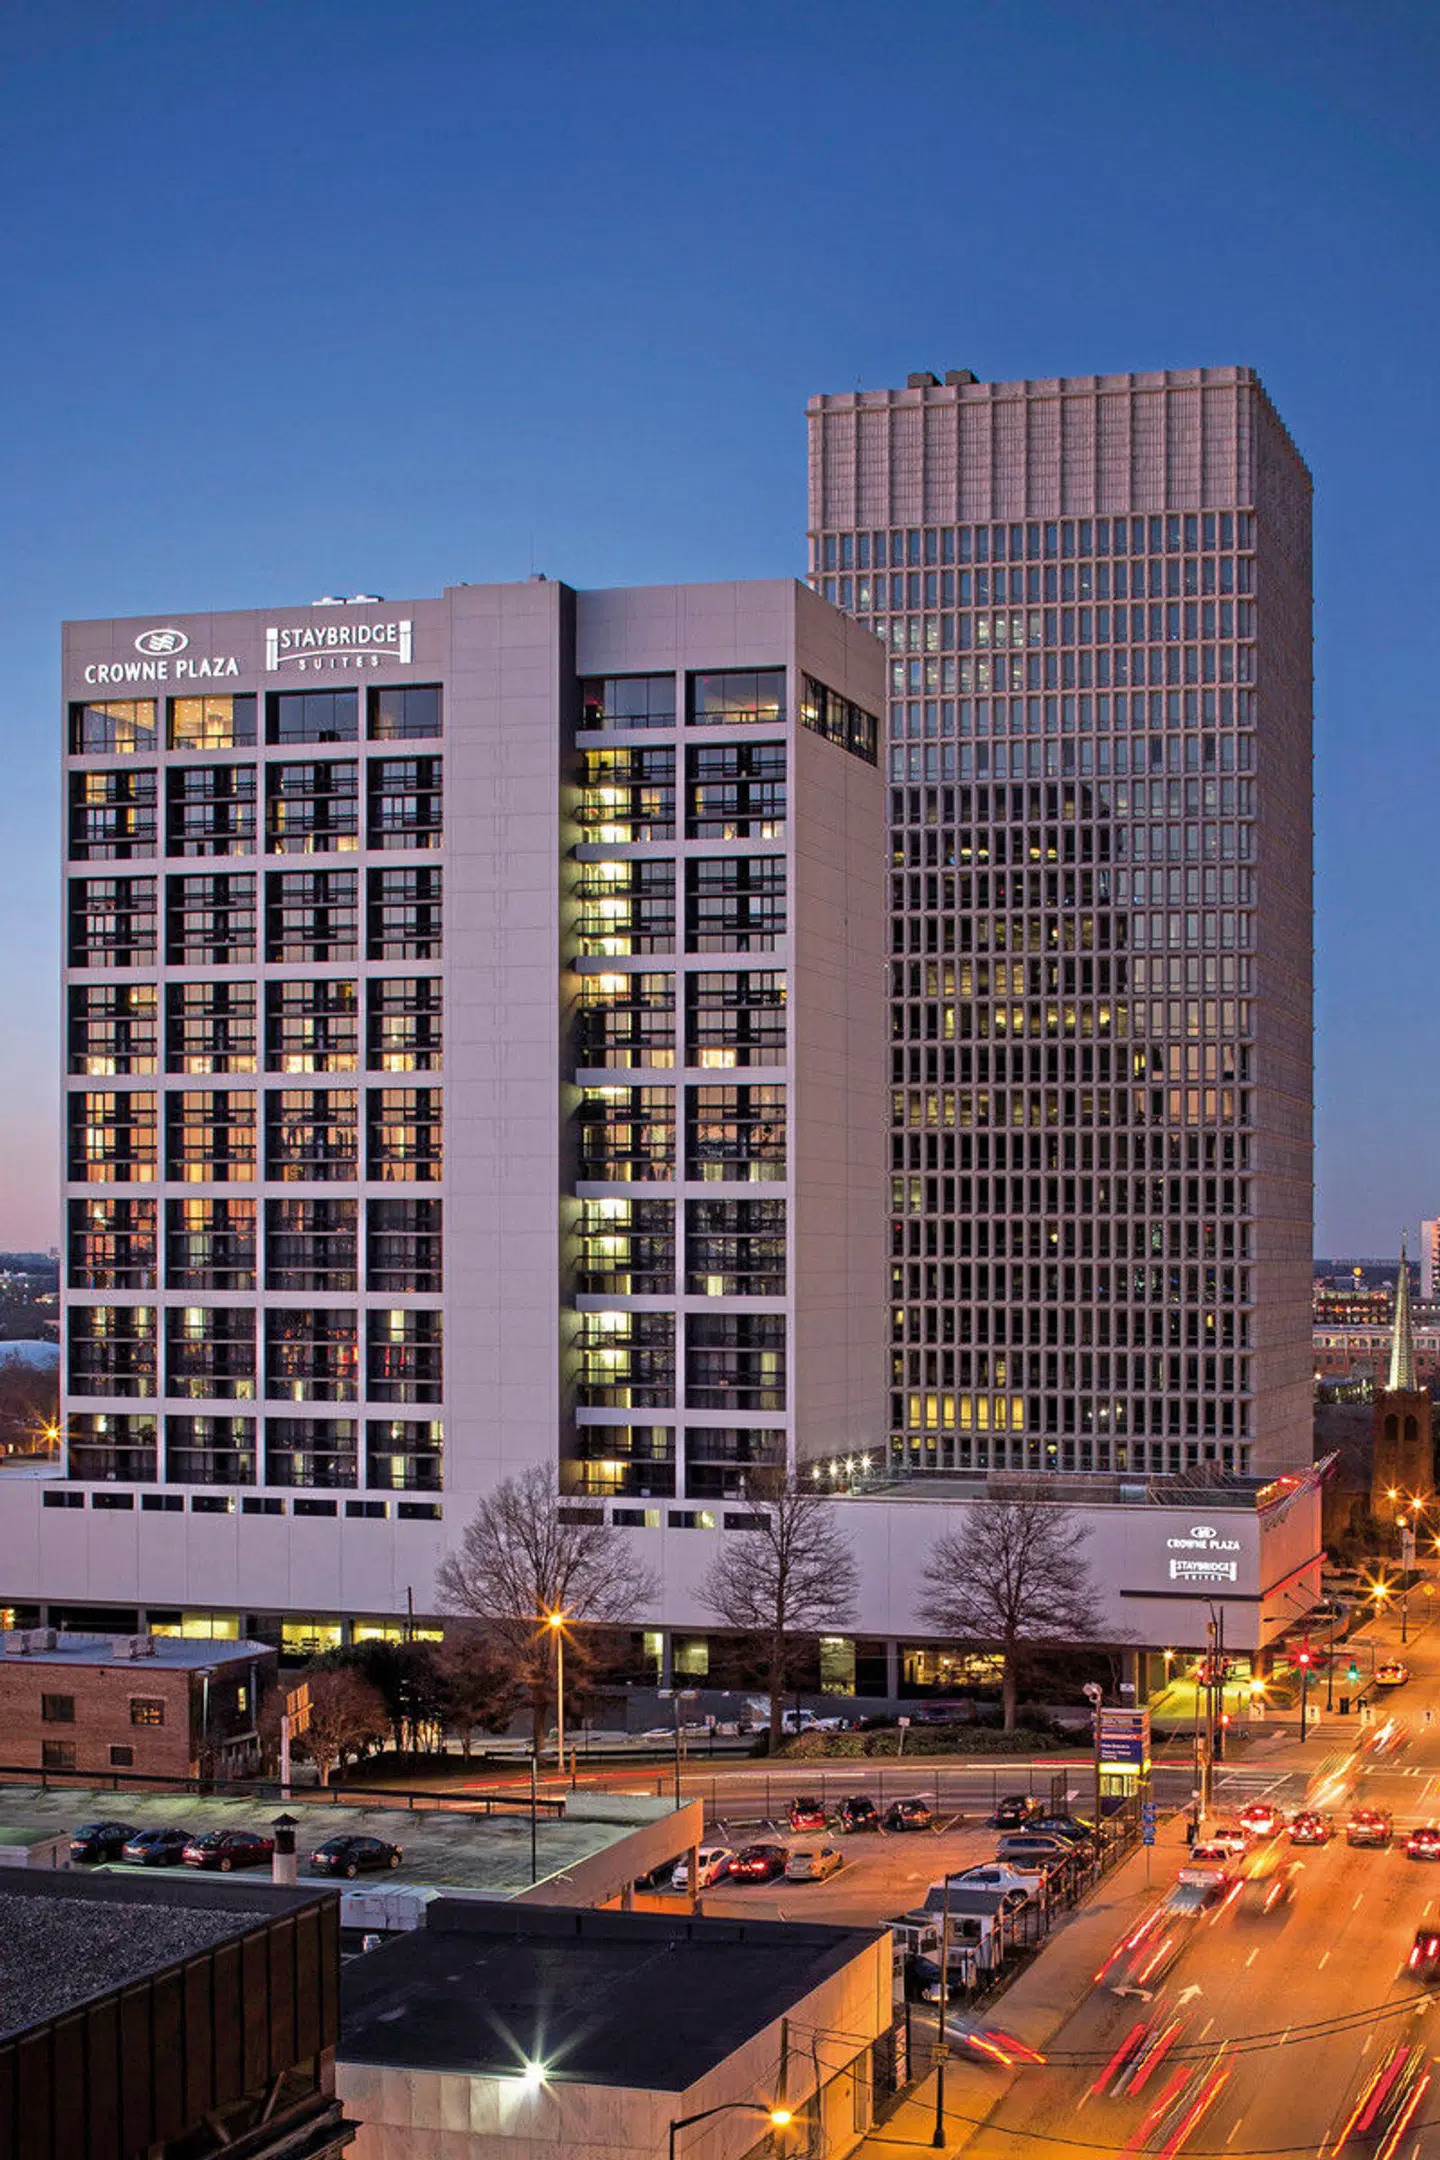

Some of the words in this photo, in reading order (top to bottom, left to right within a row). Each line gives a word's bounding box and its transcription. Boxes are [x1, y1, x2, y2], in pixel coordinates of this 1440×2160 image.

[281, 623, 397, 648] STAYBRIDGE
[84, 661, 168, 684] CROWNE
[176, 657, 239, 679] PLAZA
[299, 655, 380, 671] SUITES
[1167, 1539, 1207, 1549] CROWNE
[1209, 1540, 1240, 1550] PLAZA
